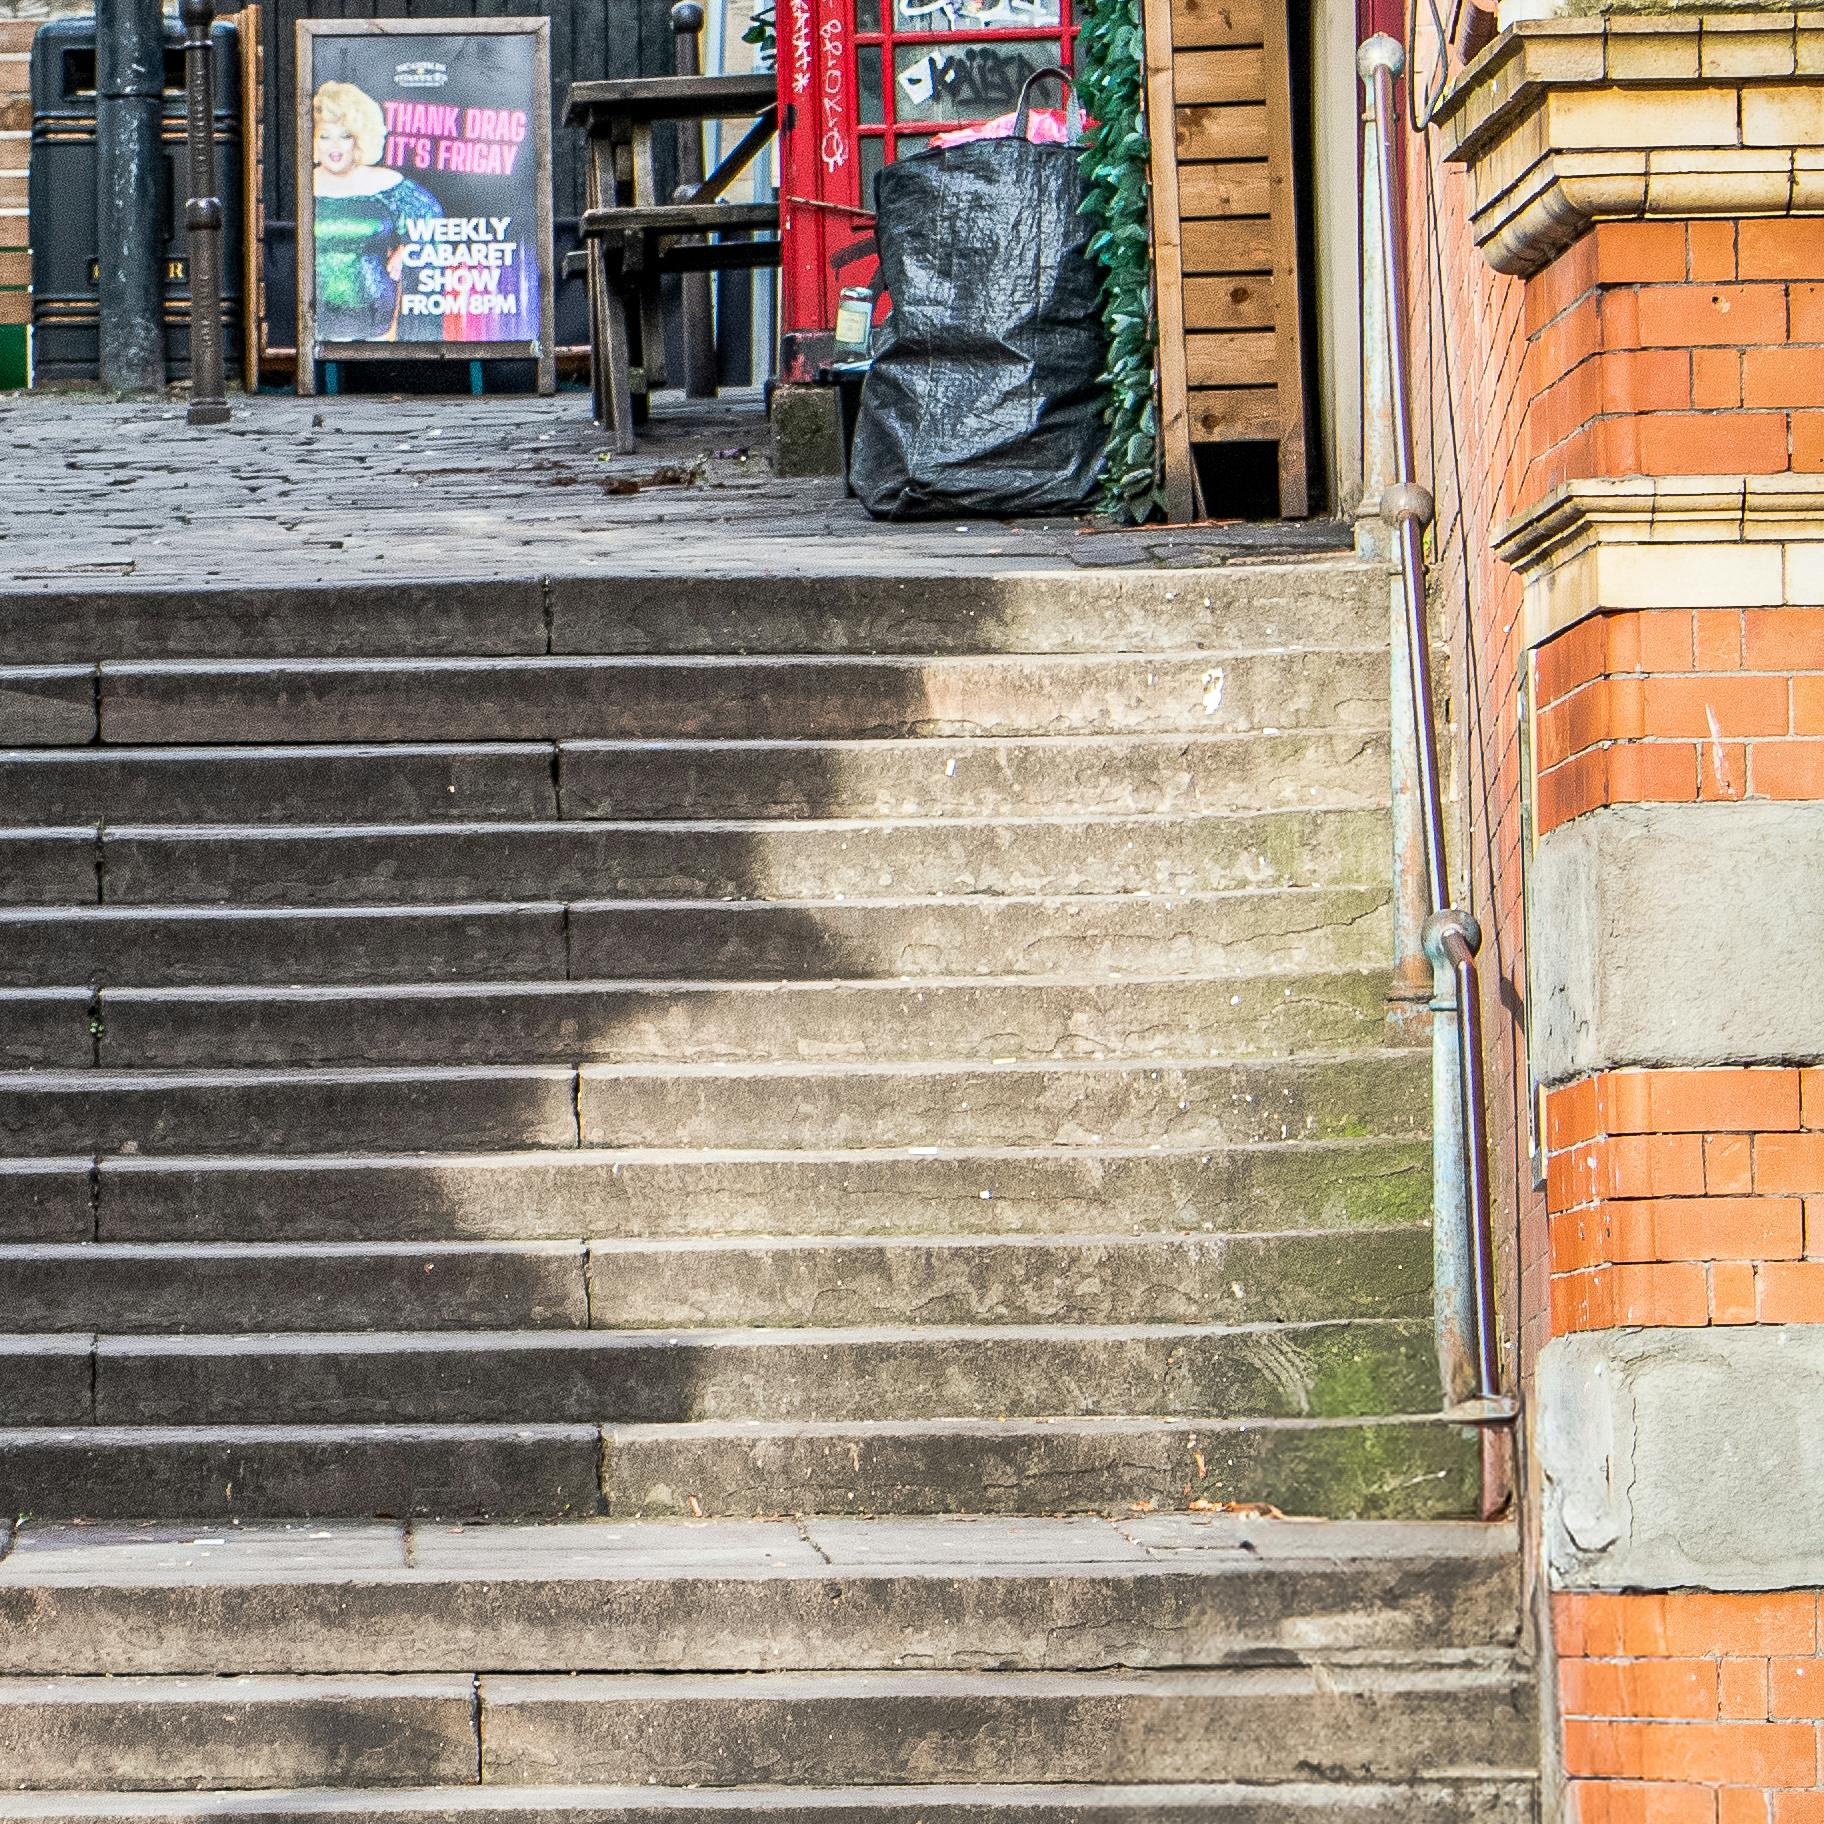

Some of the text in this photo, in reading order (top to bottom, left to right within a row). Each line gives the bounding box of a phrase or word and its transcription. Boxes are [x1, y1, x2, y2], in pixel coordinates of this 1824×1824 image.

[384, 99, 527, 143] THANK DRAG
[385, 135, 432, 169] IT'S
[406, 217, 511, 241] WEEKLY
[403, 242, 517, 267] CABARET
[417, 268, 500, 292] SHOW
[402, 294, 517, 315] FROM 8PM
